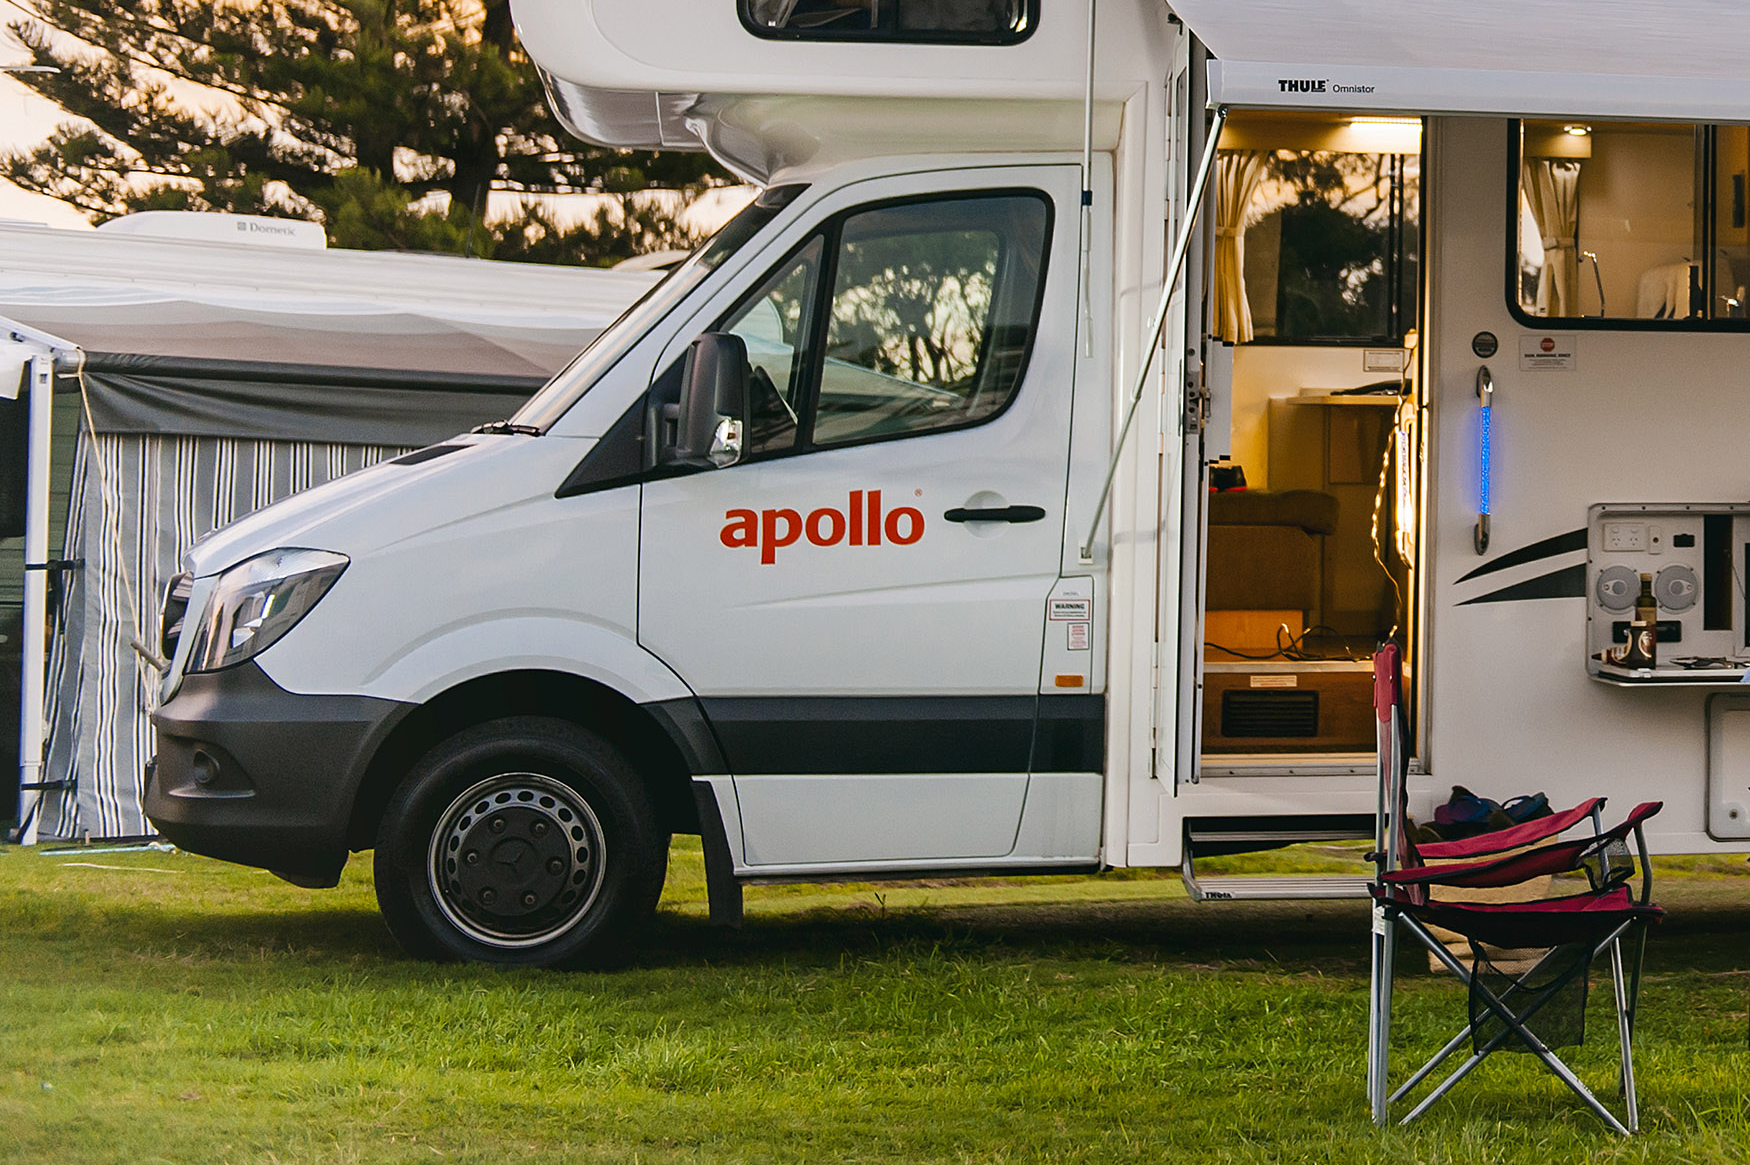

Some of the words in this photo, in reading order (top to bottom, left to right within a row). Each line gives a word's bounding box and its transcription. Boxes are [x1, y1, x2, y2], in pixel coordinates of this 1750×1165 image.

[1278, 79, 1326, 92] THULE
[1332, 84, 1375, 93] Omnistor
[249, 222, 296, 236] Dometic
[720, 489, 925, 565] apollo
